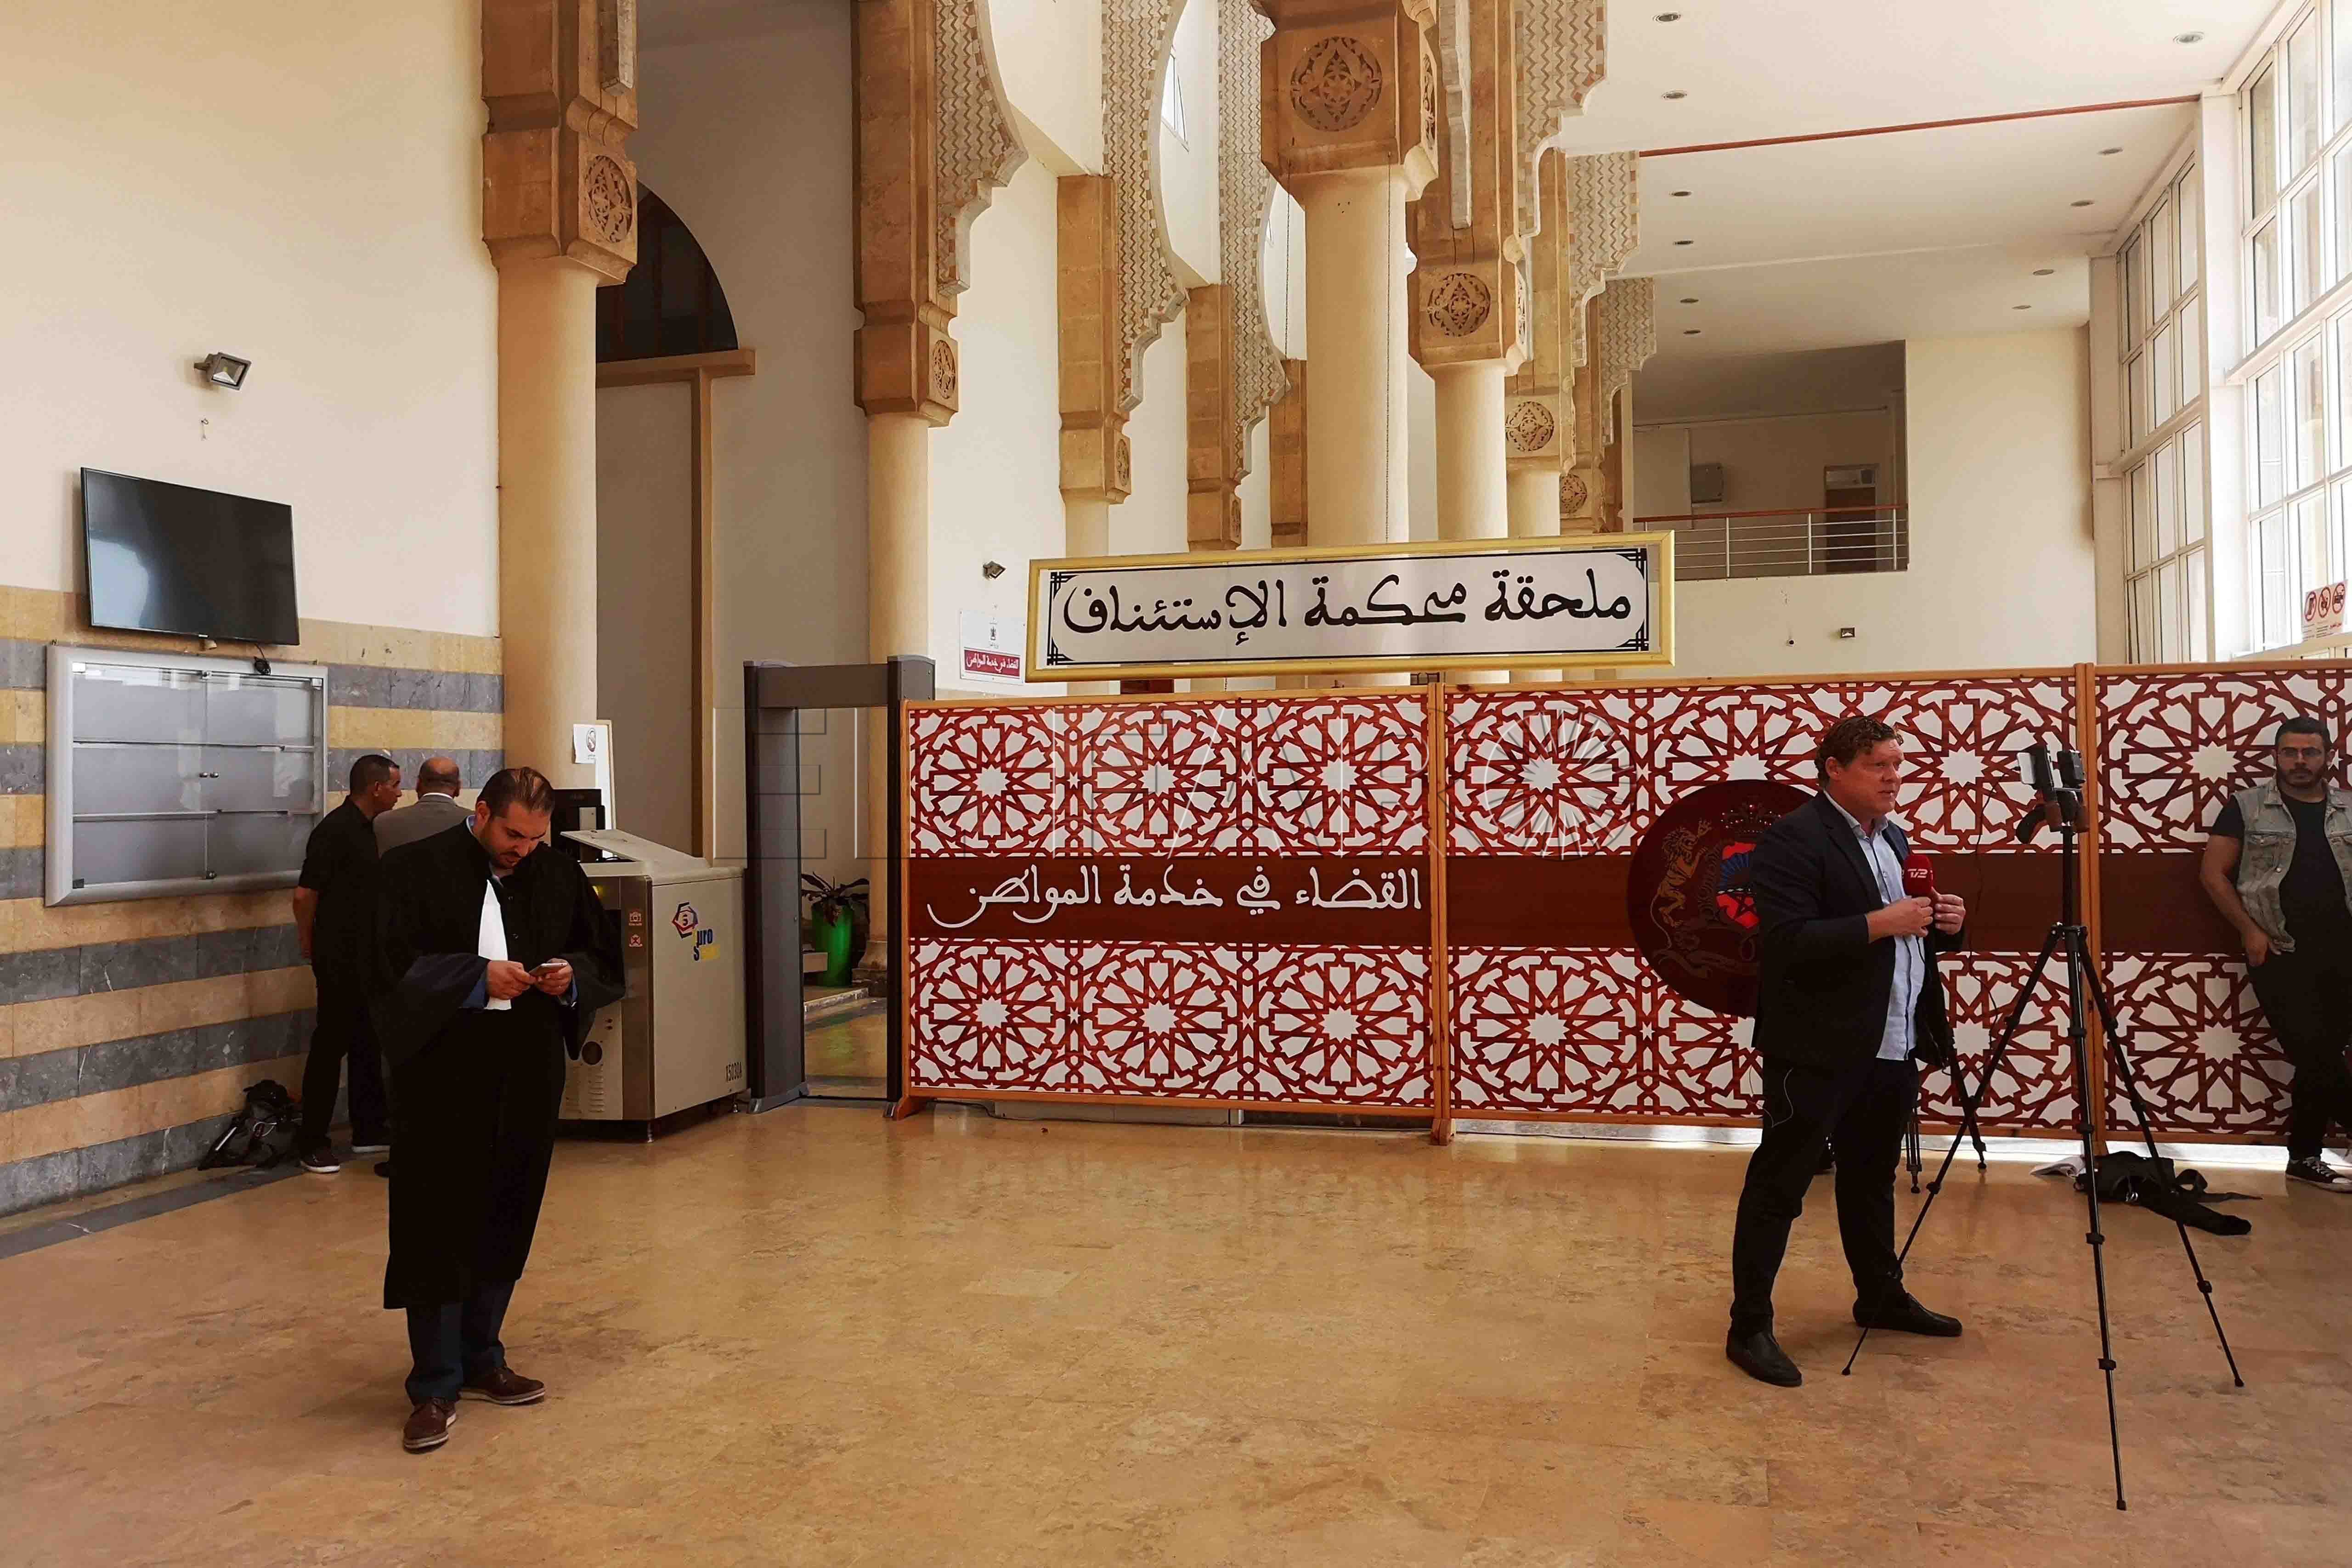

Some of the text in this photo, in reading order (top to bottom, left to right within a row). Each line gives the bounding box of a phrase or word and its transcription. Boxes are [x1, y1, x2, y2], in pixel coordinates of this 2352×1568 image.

[1063, 568, 1631, 646] ملحقة محكمة الإستئناف
[927, 864, 1422, 929] القضاء في خدمة المواطن
[1907, 869, 1928, 878] TV2
